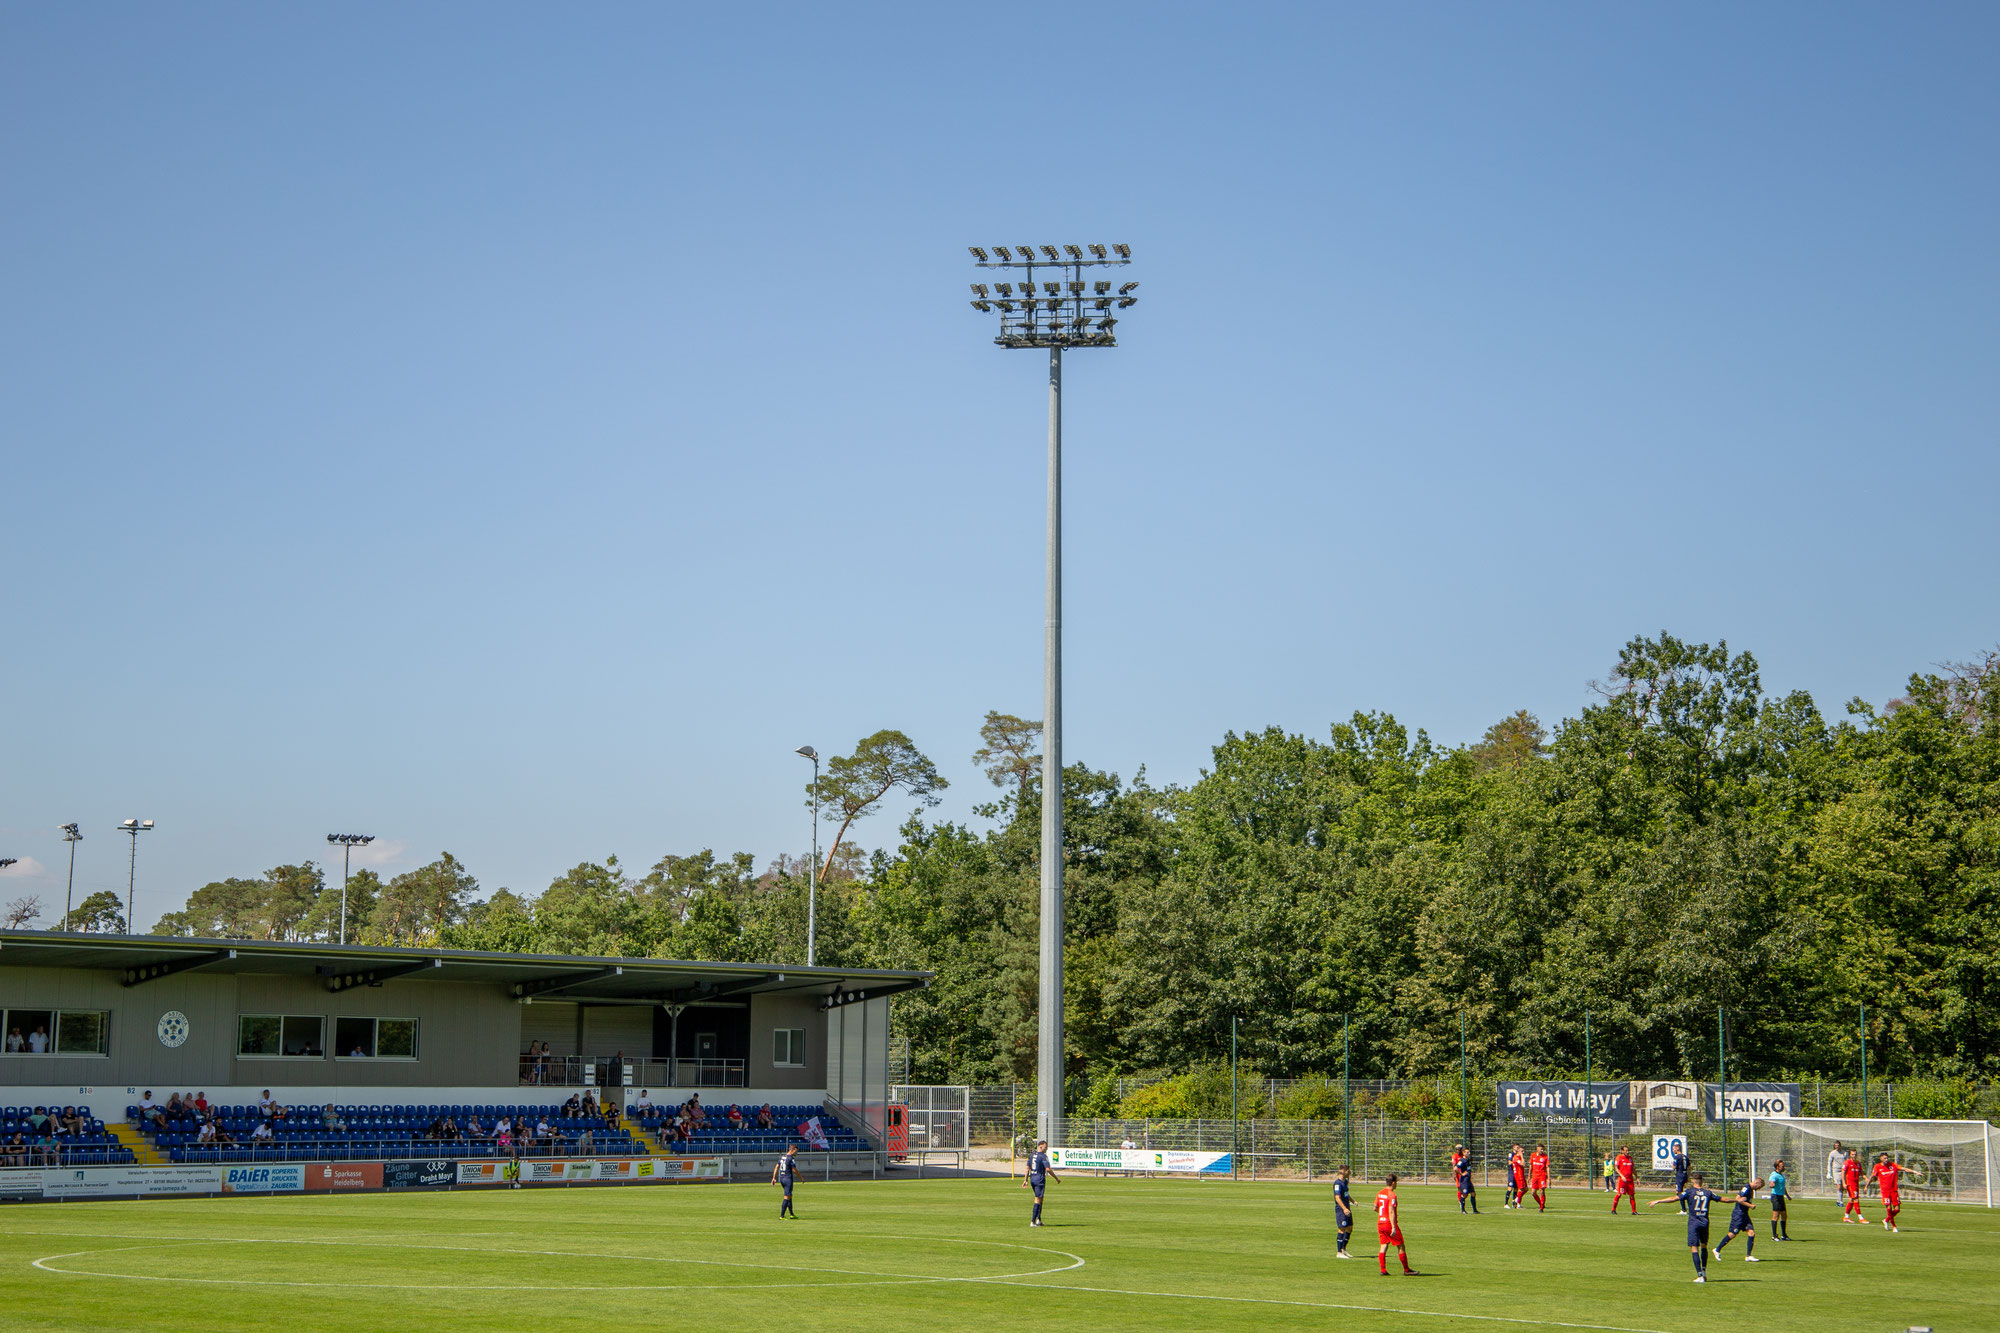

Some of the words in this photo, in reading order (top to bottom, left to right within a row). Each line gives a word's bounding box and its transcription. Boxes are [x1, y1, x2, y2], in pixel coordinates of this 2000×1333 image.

[1505, 1088, 1562, 1108] Draht
[1567, 1088, 1621, 1114] Mayr
[1594, 1116, 1613, 1125] Tore
[1065, 1150, 1093, 1159] Getränke
[1094, 1151, 1122, 1160] WIPFLER
[385, 1163, 410, 1173] Zäune
[334, 1170, 363, 1179] Sparkasse
[395, 1170, 418, 1181] Gitter
[420, 1174, 438, 1183] Draht
[438, 1172, 454, 1181] Mayr
[333, 1178, 364, 1188] Heidelberg
[1379, 1199, 1384, 1216] 7
[1693, 1195, 1708, 1211] 22
